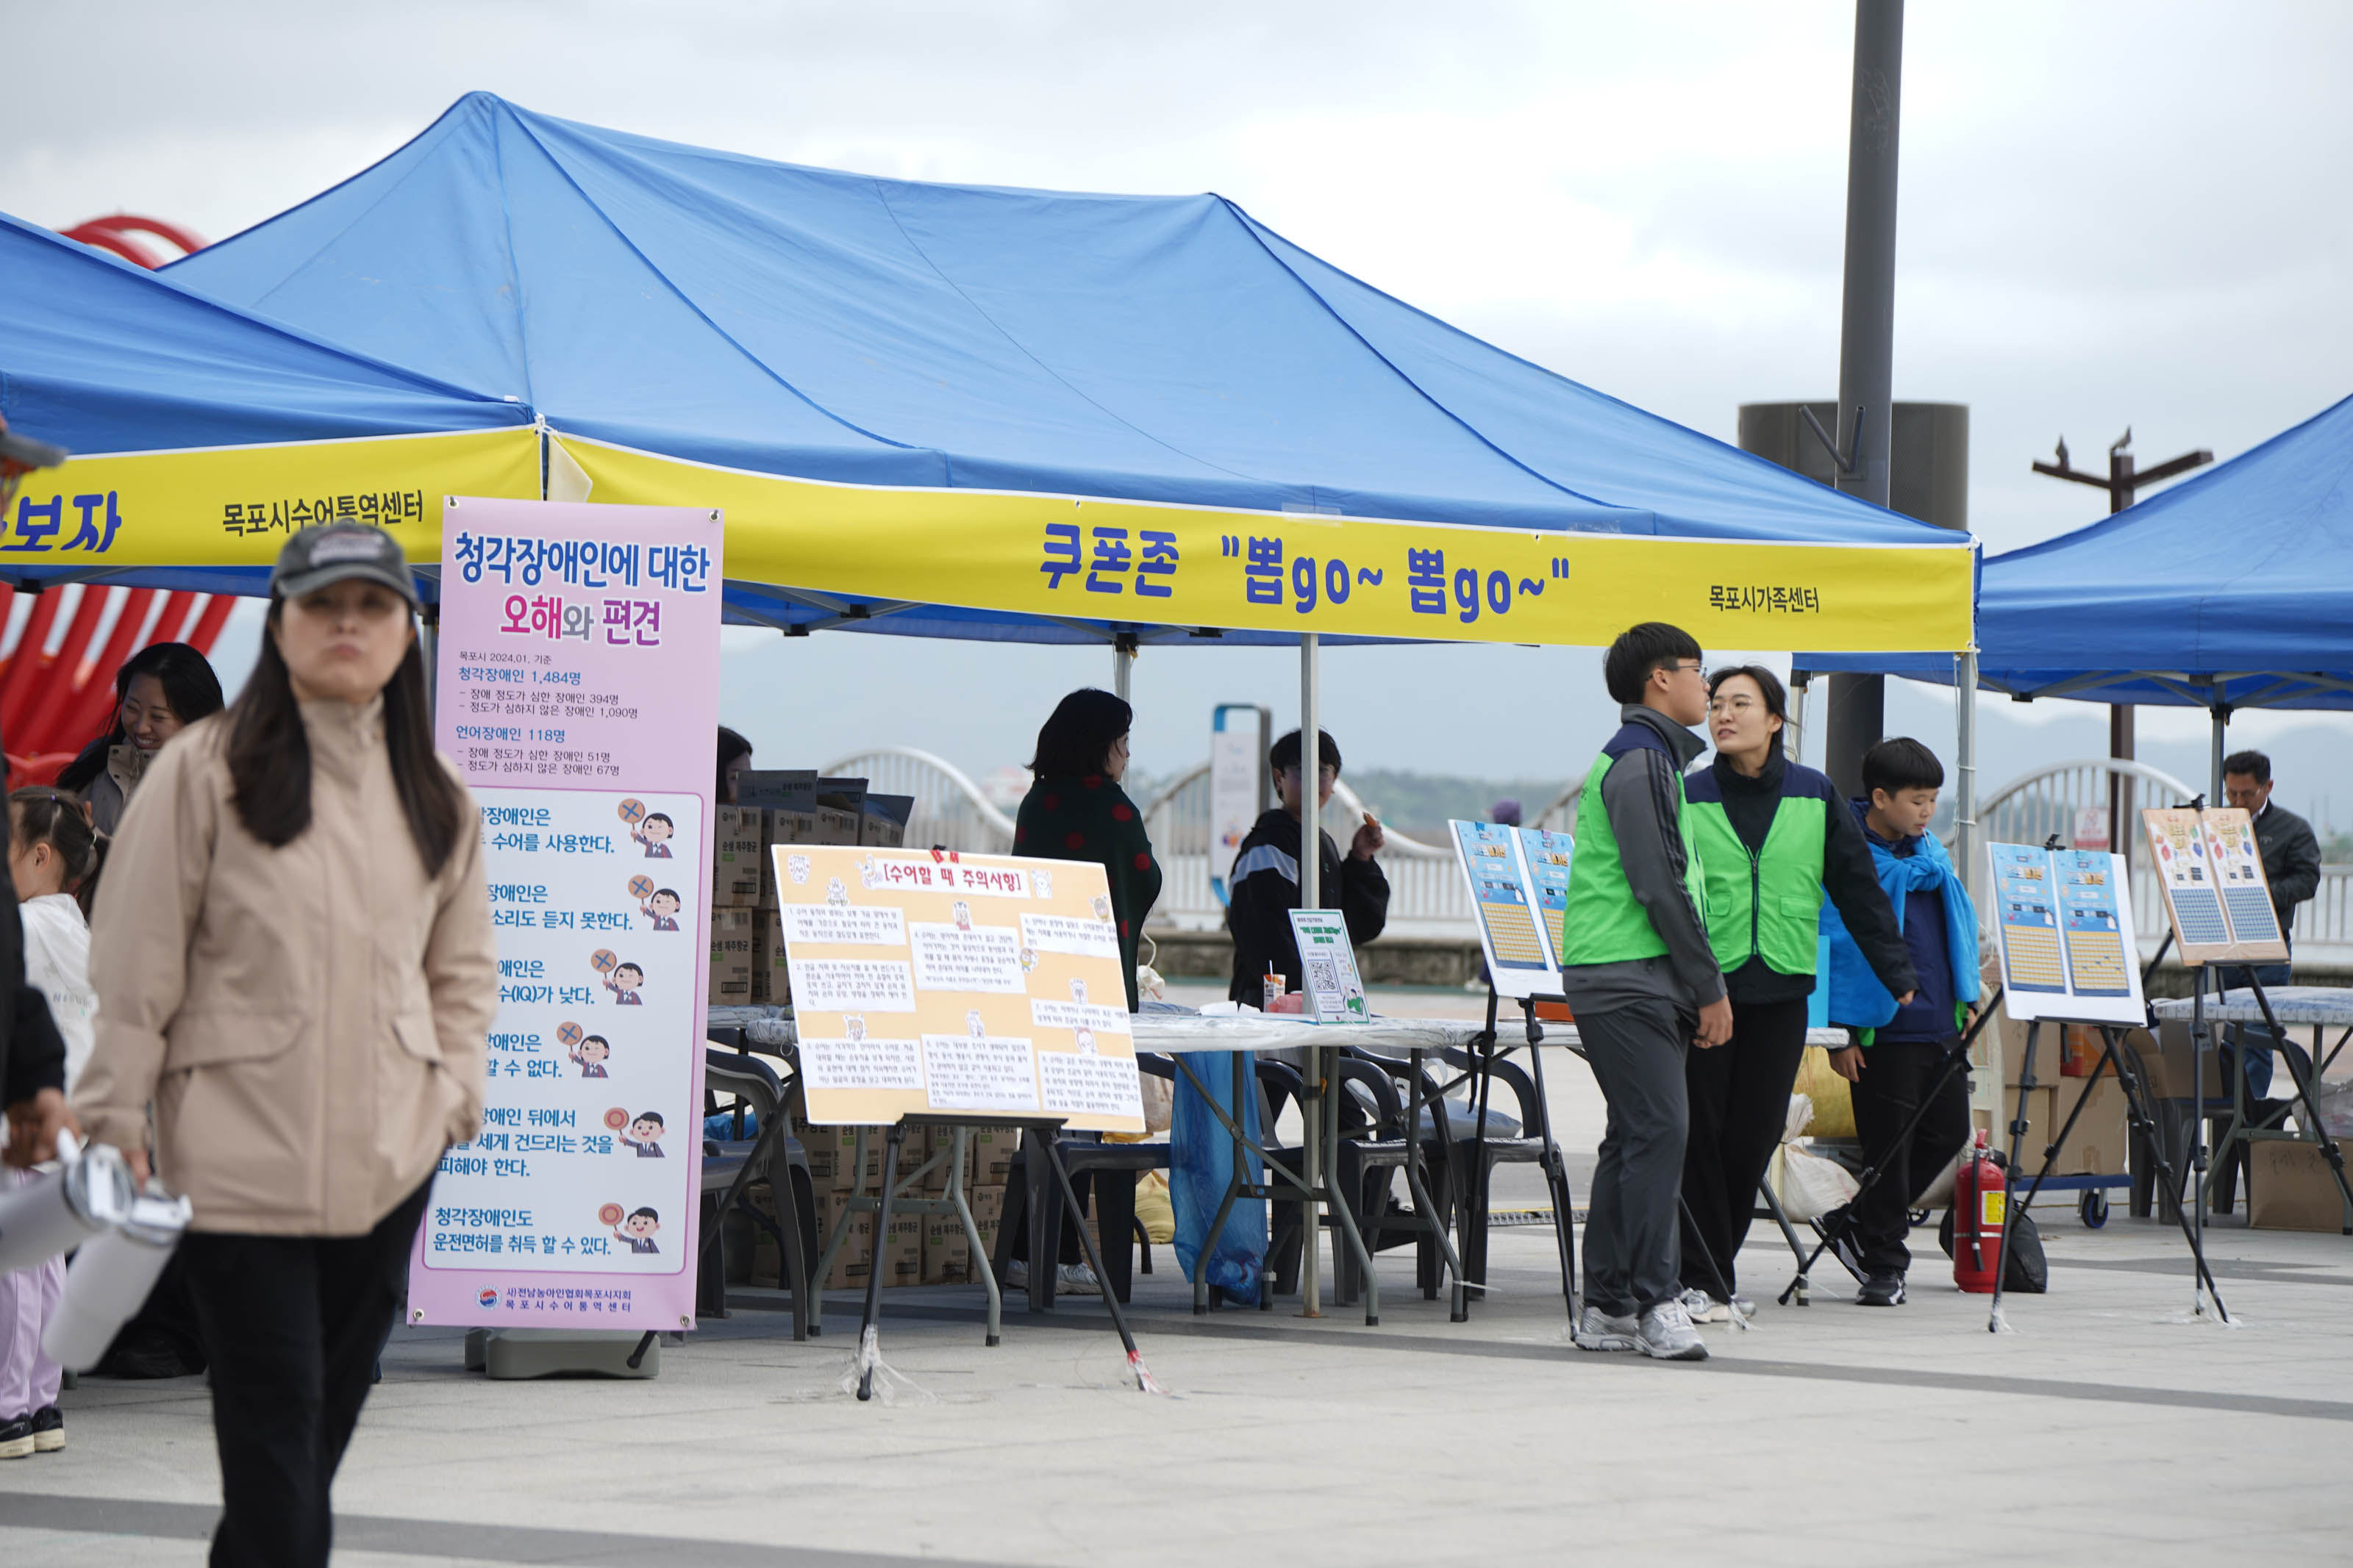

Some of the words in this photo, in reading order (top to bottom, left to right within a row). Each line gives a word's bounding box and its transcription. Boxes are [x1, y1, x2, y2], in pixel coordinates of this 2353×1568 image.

[0, 490, 122, 553] 보자
[454, 531, 640, 588] 청각장애인에
[648, 544, 710, 592] 대한
[1040, 523, 1179, 598] 쿠폰존
[1710, 585, 1819, 613] 목포시가족센터
[501, 594, 594, 641] 오해와
[602, 600, 660, 646] 편견
[460, 651, 487, 663] 목포시
[490, 653, 530, 664] 2024.01.
[535, 654, 552, 665] 기준
[458, 667, 524, 684] 청각장애인
[532, 670, 582, 685] 1,484명
[471, 689, 490, 701] 장애
[496, 690, 526, 702] 정도가
[530, 691, 551, 703] 심한
[555, 692, 585, 704] 장애인
[589, 694, 618, 705] 394명
[470, 702, 499, 714] 정도가
[506, 704, 535, 715] 심하지
[540, 704, 560, 716] 않은
[565, 705, 595, 717] 장애인
[600, 707, 638, 719] 1,090명
[456, 725, 521, 742] 언어장애인
[529, 728, 565, 743] 118명
[468, 747, 488, 759] 장애
[493, 748, 524, 759] 정도가
[528, 749, 548, 761] 심한
[553, 750, 583, 762] 장애인
[588, 751, 610, 762] 51명
[468, 760, 497, 772] 정도가
[502, 762, 533, 773] 심하지
[538, 762, 557, 774] 않은
[563, 763, 593, 776] 장애인
[597, 765, 619, 776] 67명
[480, 806, 551, 826] 장애인은
[492, 833, 540, 851] 수어를
[546, 834, 615, 853] 사용한다.
[941, 867, 954, 887] 때
[488, 884, 549, 903] 장애인은
[493, 910, 536, 928] 소리도
[542, 911, 574, 929] 듣지
[580, 912, 633, 930] 못한다.
[498, 959, 545, 978] 애인은
[498, 984, 553, 1004] 수(IQ)가
[559, 987, 594, 1004] 낮다.
[485, 1033, 541, 1052] 애인은
[504, 1059, 521, 1077] 수
[526, 1059, 563, 1078] 없다.
[527, 1109, 576, 1128] 뒤에서
[476, 1134, 509, 1151] 세게
[514, 1135, 577, 1153] 건드리는
[582, 1136, 613, 1154] 것을
[439, 1157, 487, 1176] 피해야
[494, 1159, 530, 1177] 한다.
[435, 1207, 534, 1228] 청각장애인도
[433, 1233, 503, 1253] 운전면허를
[508, 1234, 536, 1253] 취득
[542, 1236, 557, 1253] 할
[561, 1236, 576, 1254] 수
[580, 1236, 611, 1256] 있다.
